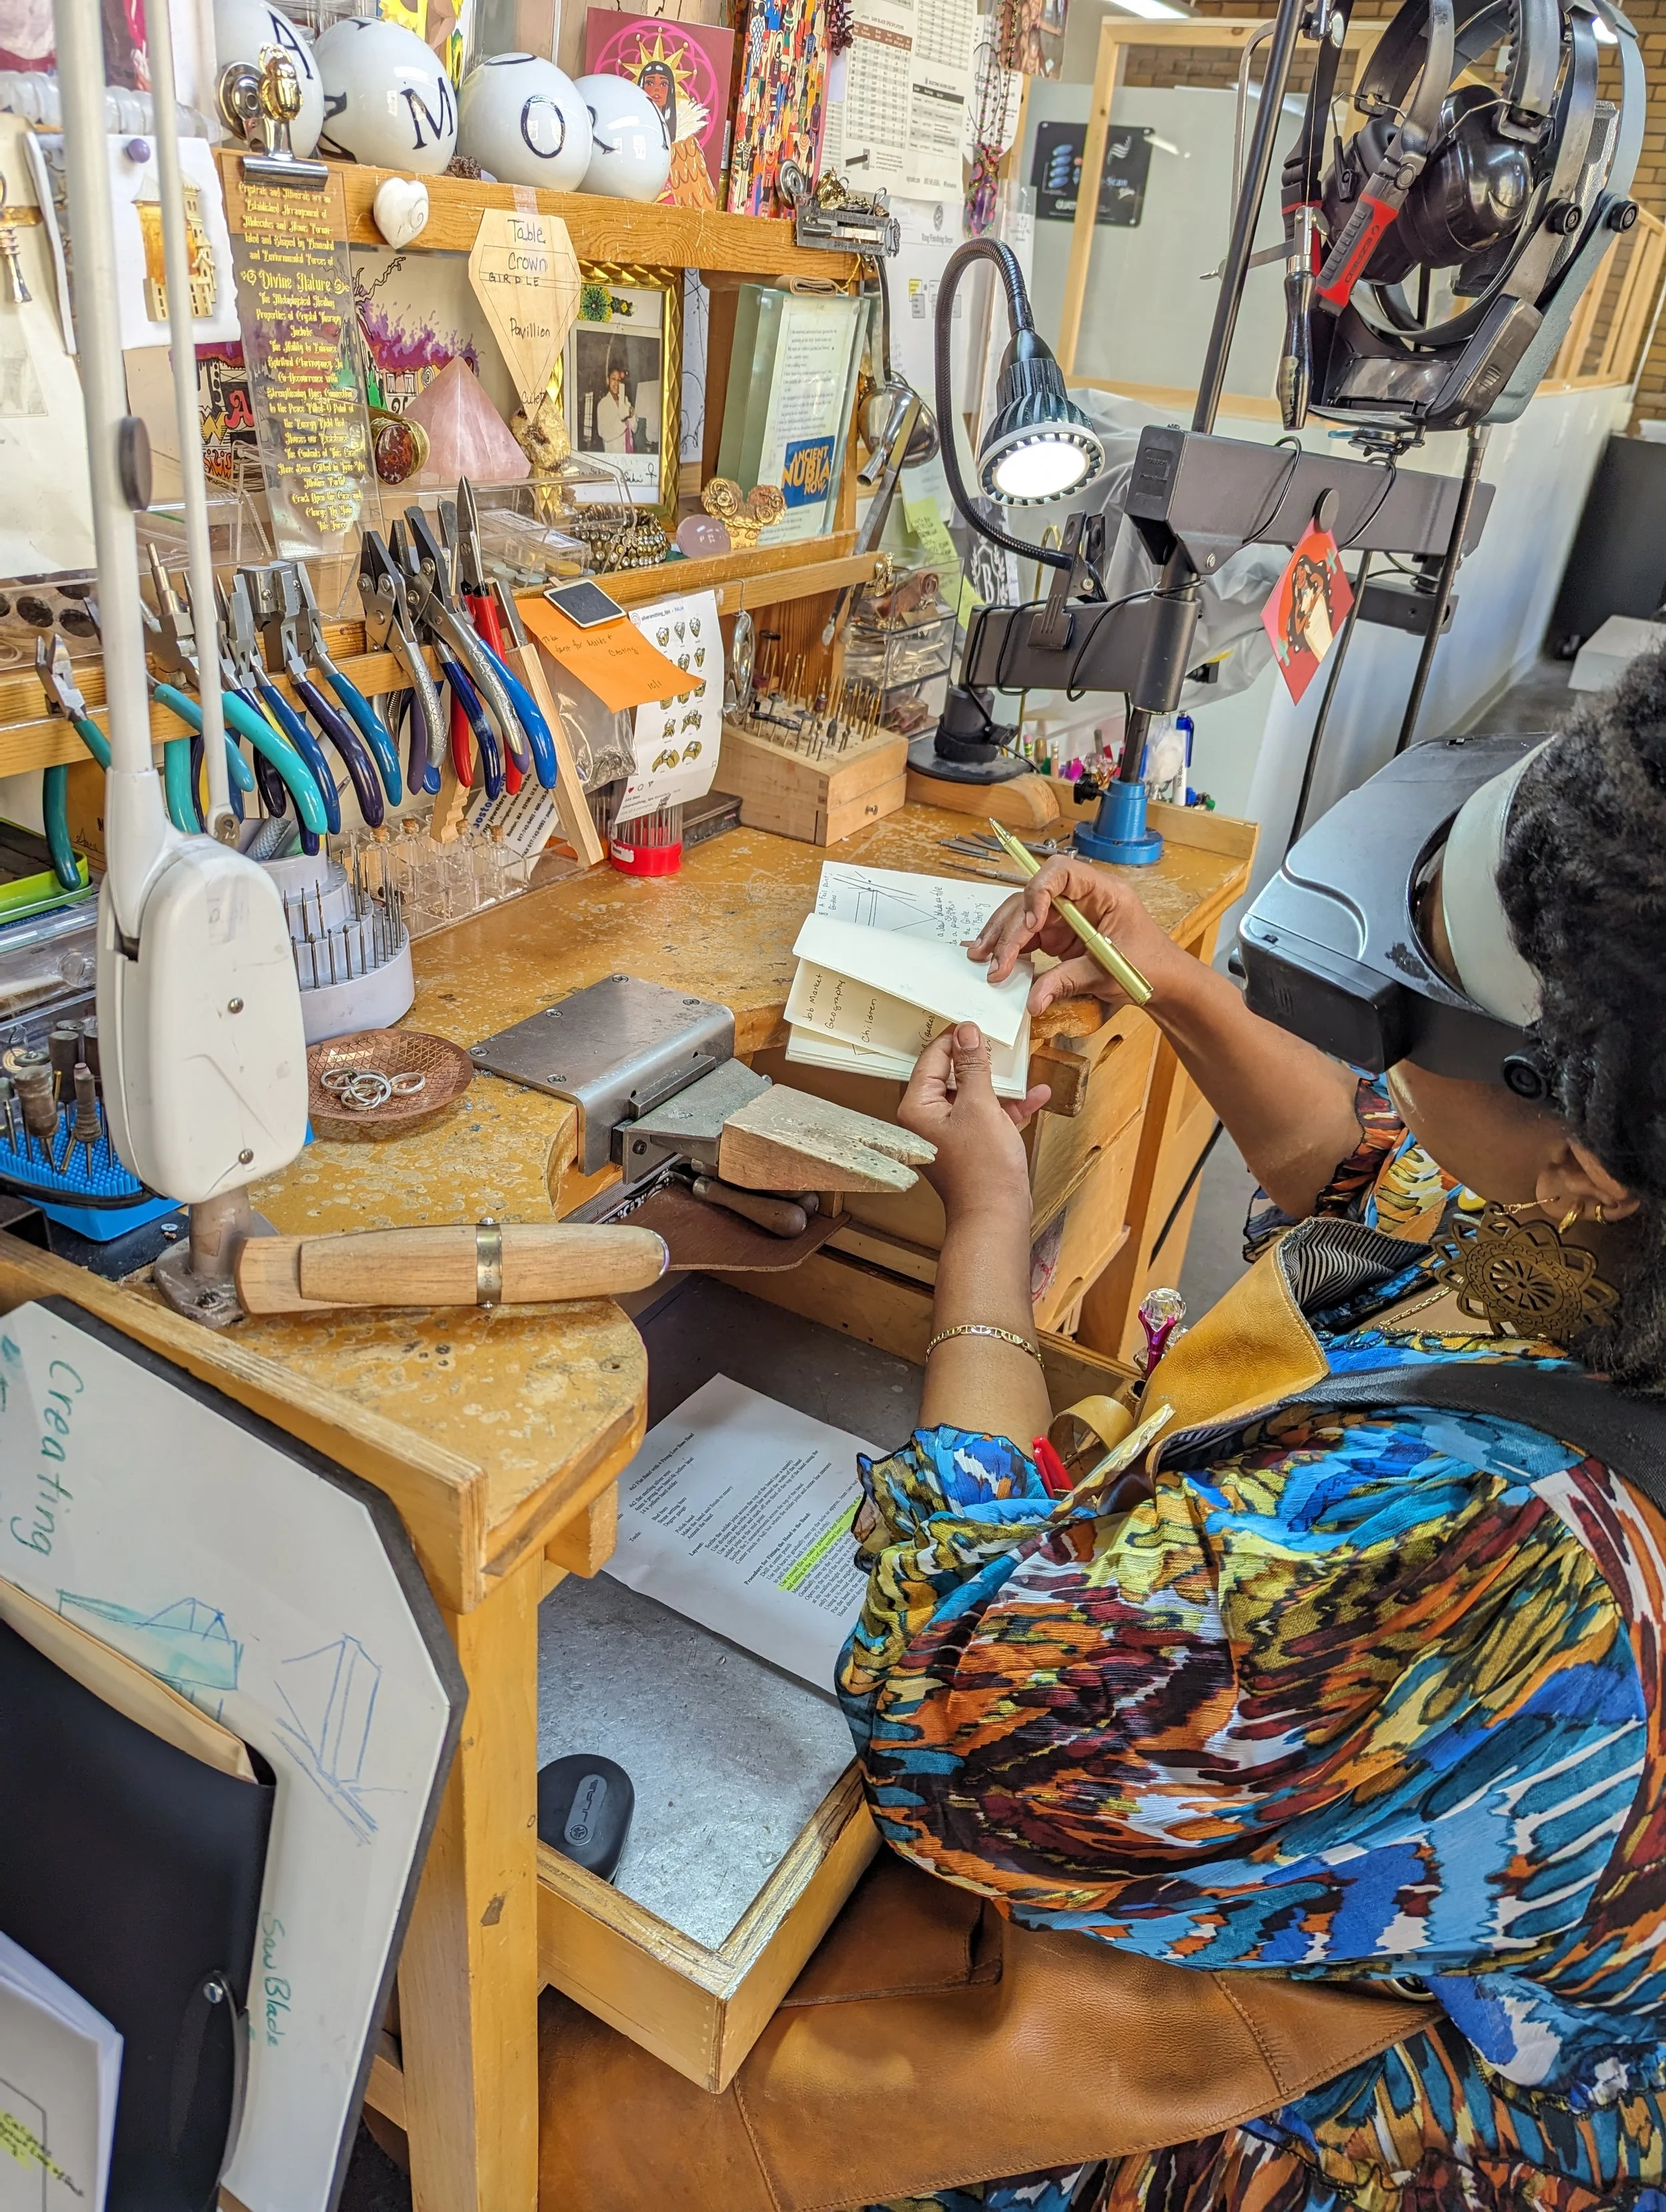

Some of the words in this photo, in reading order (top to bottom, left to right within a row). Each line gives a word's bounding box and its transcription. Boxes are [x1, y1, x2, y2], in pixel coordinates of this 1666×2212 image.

[267, 10, 314, 79] A
[401, 77, 453, 150] M
[520, 95, 565, 159] O
[508, 219, 546, 243] Table
[508, 253, 548, 273] Crown
[259, 271, 292, 289] Divine
[297, 273, 331, 292] Nature
[489, 273, 540, 286] GIRDLE
[510, 317, 550, 338] Pavillion
[791, 446, 829, 463] ANCIENT
[782, 458, 830, 488] NUBIA
[804, 480, 827, 496] NOW
[982, 563, 994, 605] B
[488, 794, 507, 824] jewelers
[516, 812, 523, 820] MA
[802, 1007, 814, 1022] Job
[809, 973, 823, 1004] Market
[824, 979, 846, 1029] Geography
[861, 998, 877, 1043] Children
[9, 1359, 85, 1557] Creating
[688, 1540, 705, 1557] Layout:
[744, 1564, 764, 1585] Procedure
[766, 1546, 780, 1561] Fitting
[782, 1530, 793, 1542] Head
[799, 1511, 811, 1523] Band:
[263, 1976, 291, 2047] Blade
